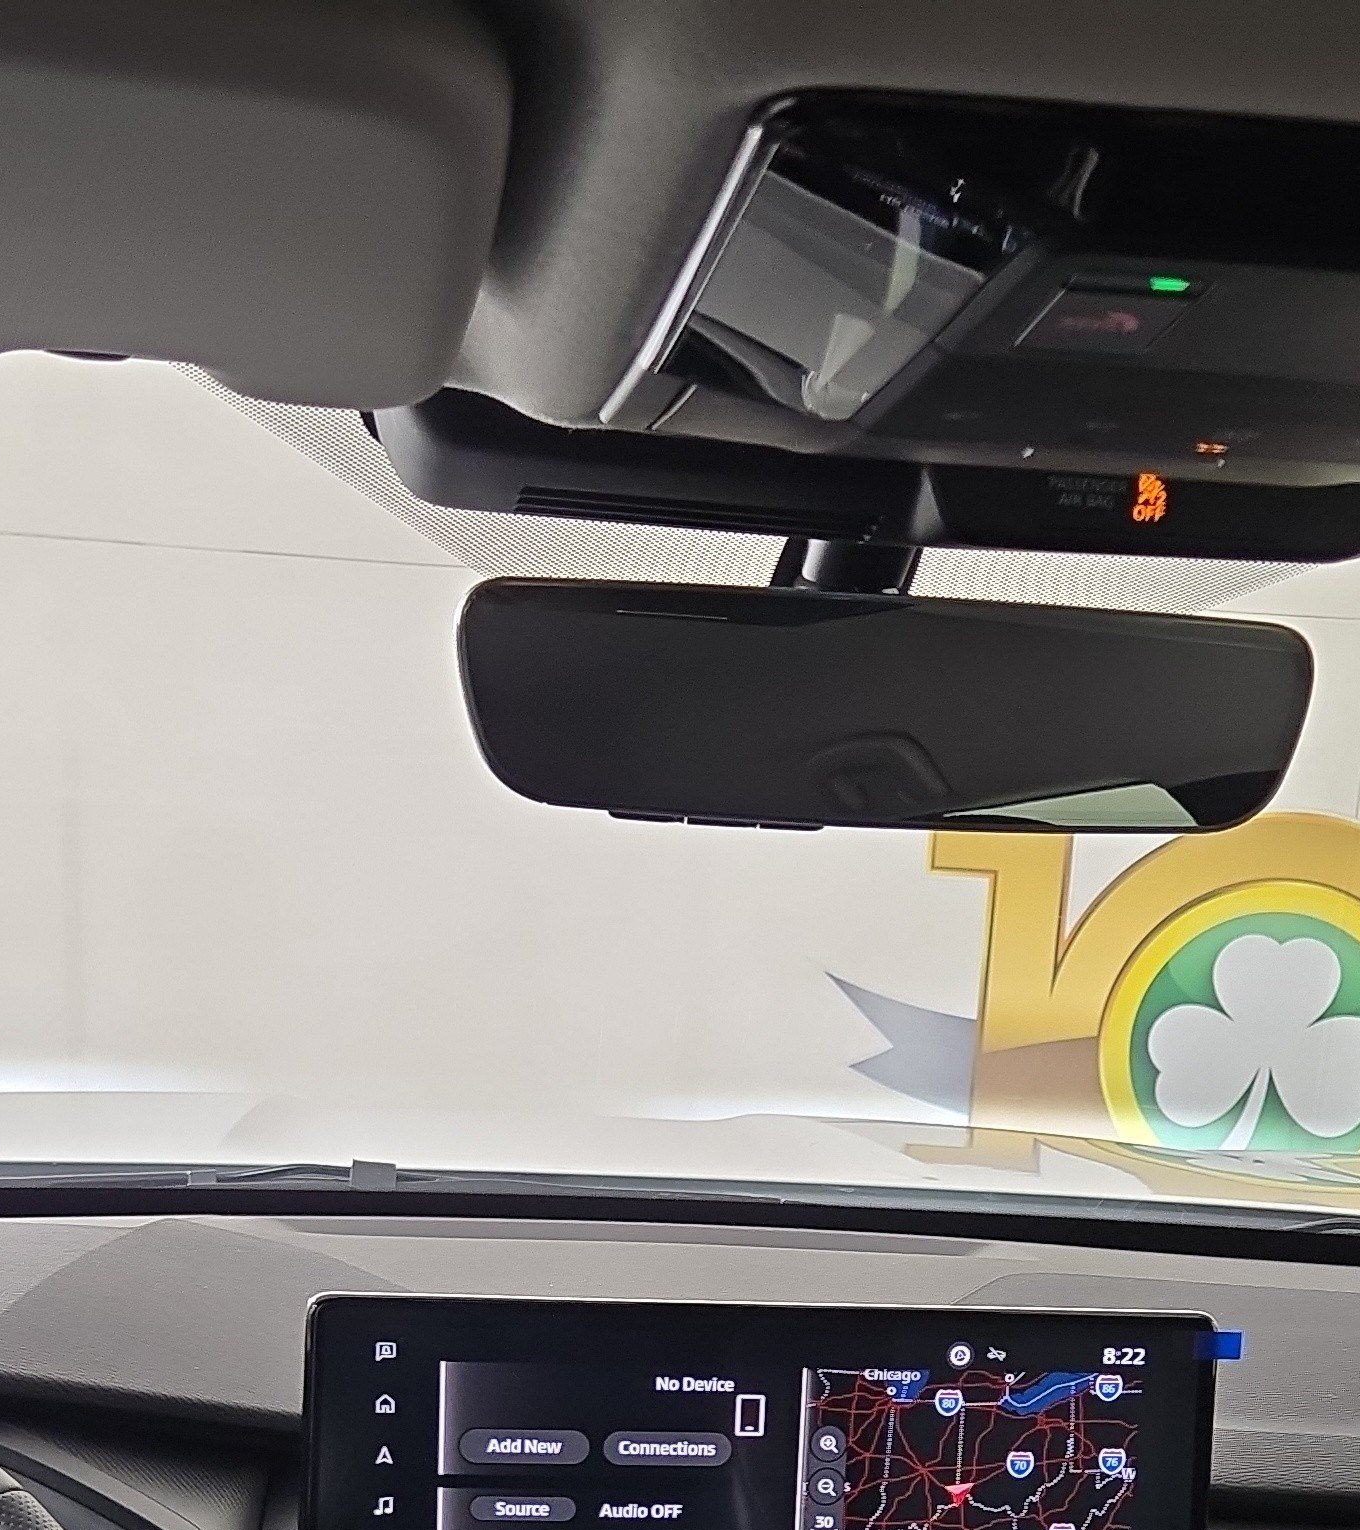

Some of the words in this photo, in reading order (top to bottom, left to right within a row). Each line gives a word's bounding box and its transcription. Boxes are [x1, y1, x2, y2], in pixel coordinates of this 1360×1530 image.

[1132, 503, 1167, 522] OFF
[1102, 1347, 1146, 1365] 8:22
[863, 1368, 922, 1383] Chicago
[655, 1376, 680, 1392] No
[682, 1376, 735, 1393] Device
[486, 1438, 522, 1454] Add
[523, 1439, 563, 1454] New
[617, 1440, 717, 1457] Connections
[494, 1501, 550, 1517] Source
[598, 1503, 648, 1519] Audio
[650, 1504, 683, 1519] OFF
[814, 1516, 834, 1529] 30
